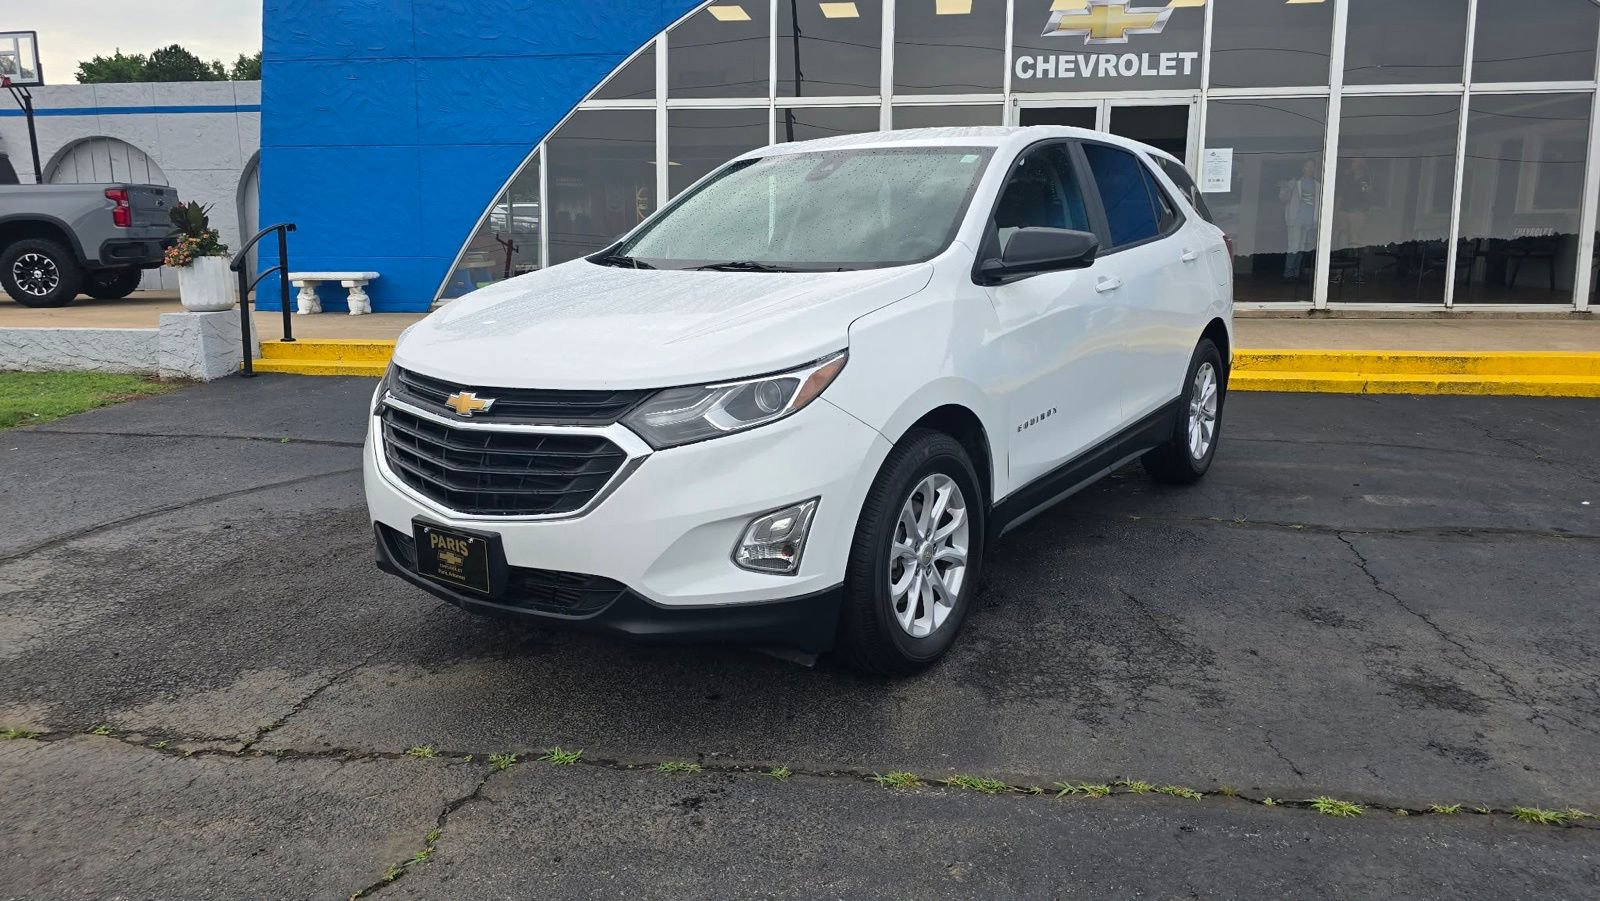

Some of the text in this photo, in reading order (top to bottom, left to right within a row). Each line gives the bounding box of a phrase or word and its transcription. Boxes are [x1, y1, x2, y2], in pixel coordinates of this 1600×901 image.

[1015, 52, 1198, 79] CHEVROLET
[1017, 406, 1057, 432] EQUINOX
[430, 533, 469, 557] PARIS
